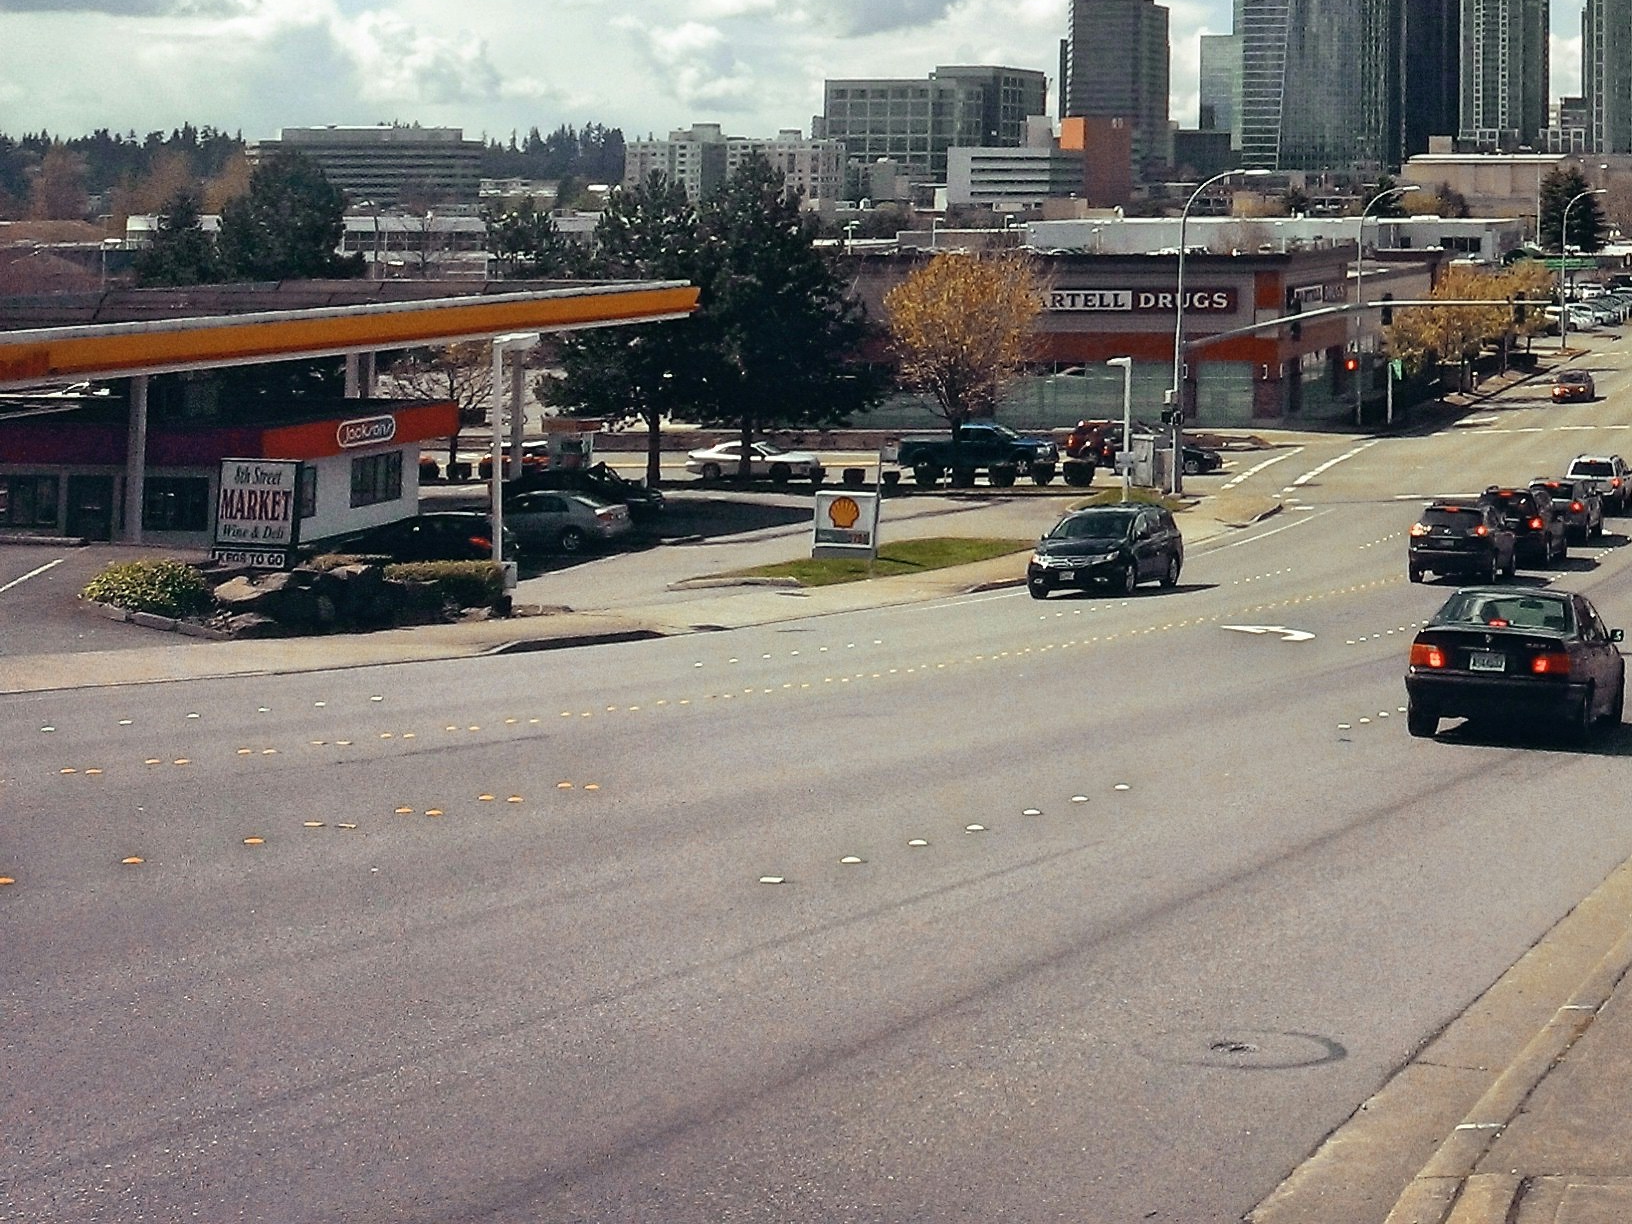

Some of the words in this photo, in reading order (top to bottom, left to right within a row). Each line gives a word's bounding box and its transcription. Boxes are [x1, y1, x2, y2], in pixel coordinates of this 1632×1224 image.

[1041, 292, 1126, 308] RTELL
[1138, 292, 1229, 309] DRUGS
[254, 466, 282, 485] Street
[220, 489, 292, 521] MARKET
[223, 523, 247, 537] Wine
[262, 525, 284, 539] Deli
[249, 553, 265, 565] TO
[267, 554, 284, 565] GO
